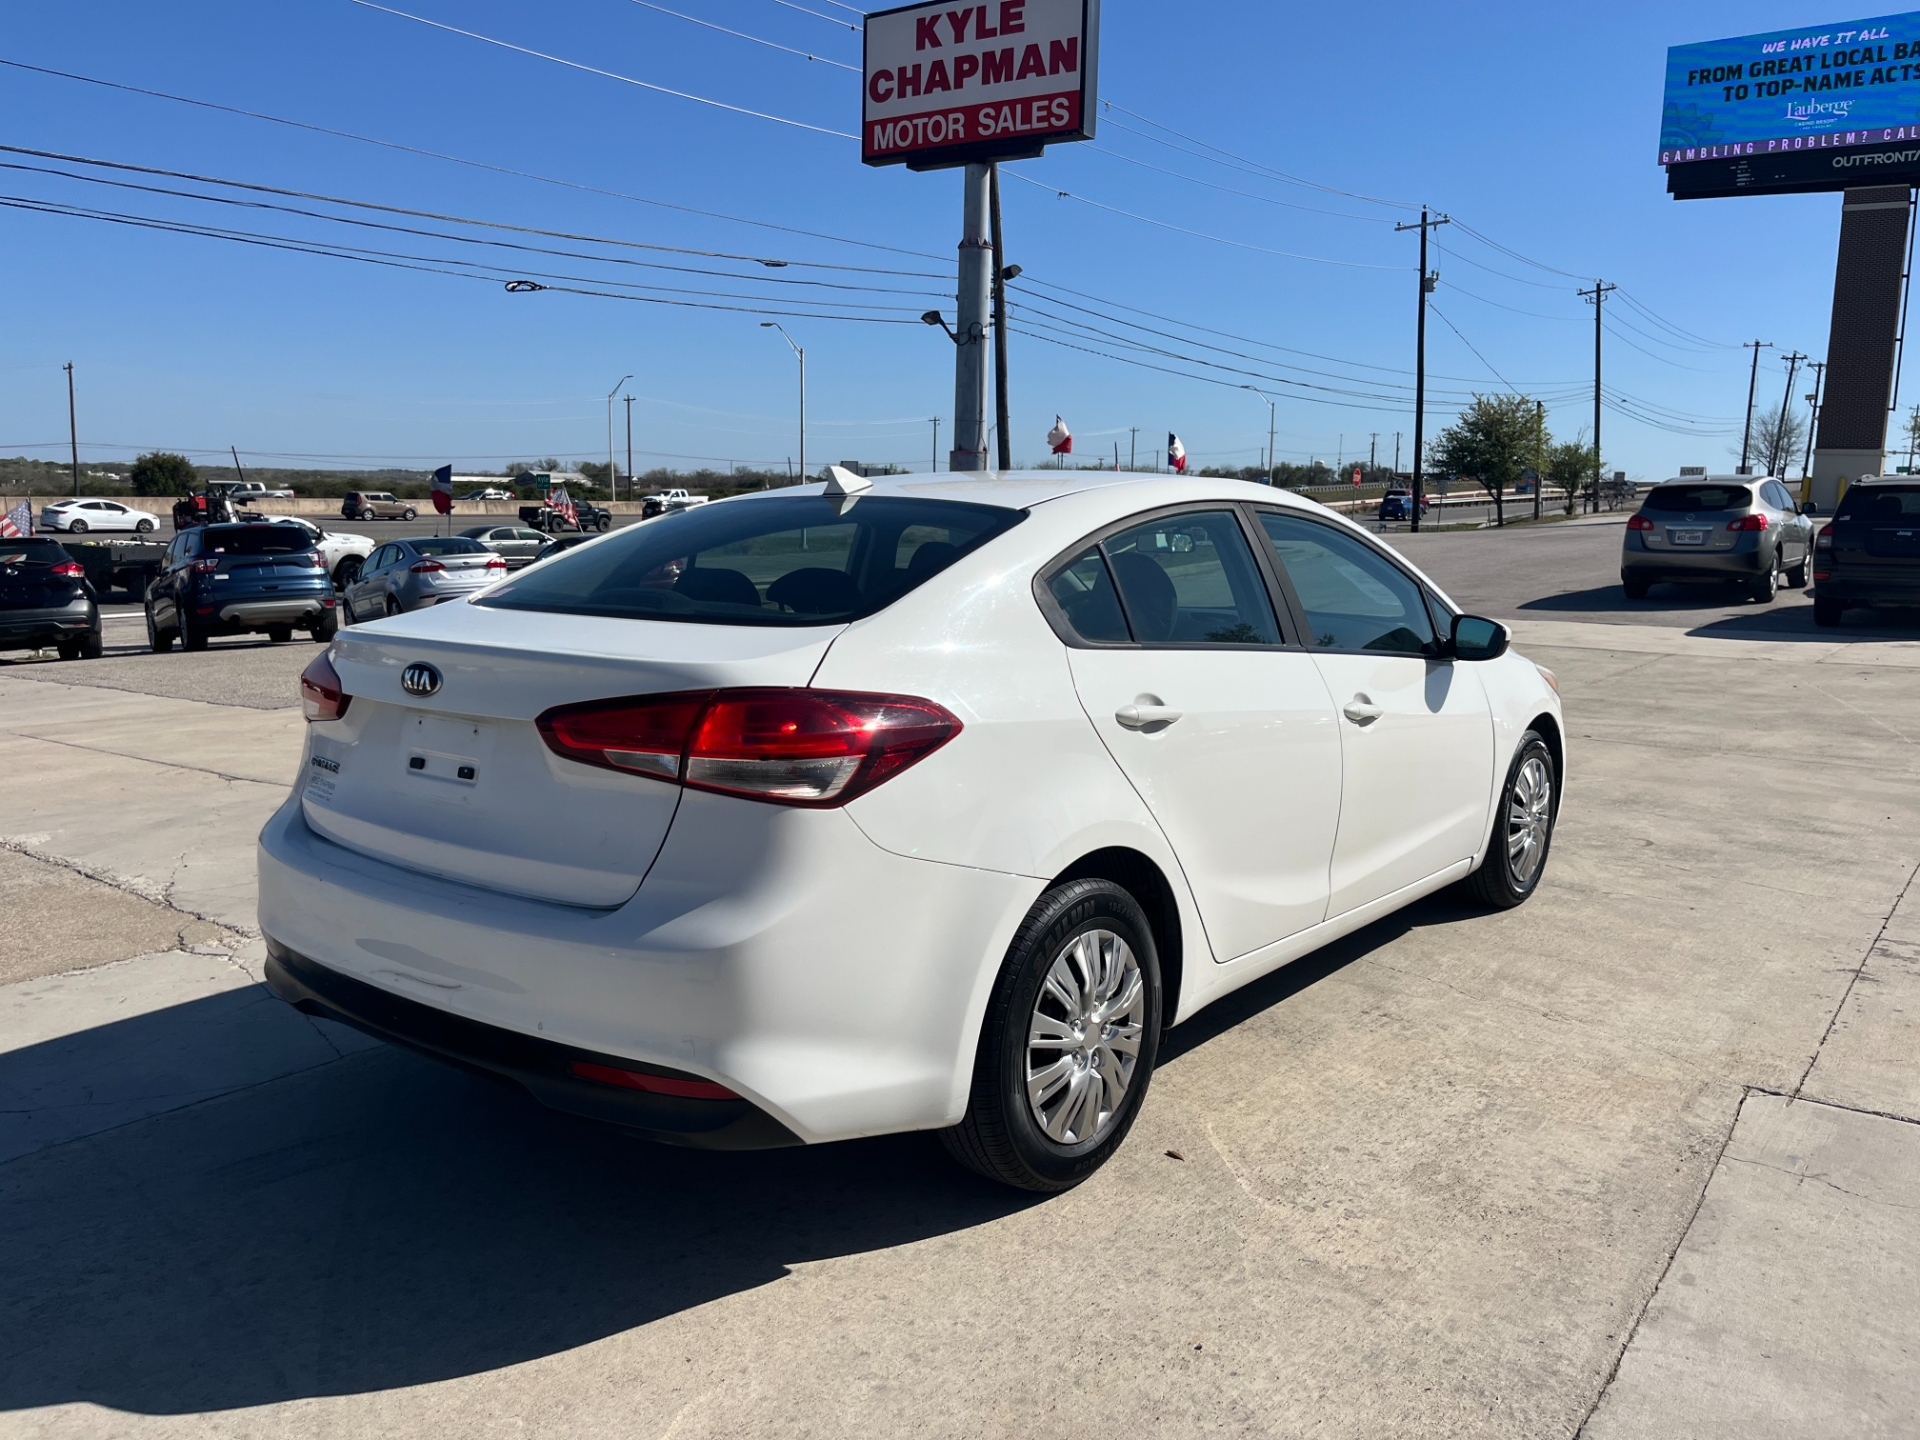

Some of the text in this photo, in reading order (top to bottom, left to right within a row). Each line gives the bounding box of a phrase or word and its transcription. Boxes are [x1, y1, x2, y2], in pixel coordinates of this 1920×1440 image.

[916, 0, 1026, 51] KYLE
[1762, 27, 1890, 54] WE HAVE IT ALL
[869, 36, 1078, 103] CHAPMAN
[1688, 64, 1743, 86] FROM
[1750, 54, 1816, 78] GREAT
[1820, 45, 1888, 69] LOCAL
[1723, 84, 1749, 102] TO
[1755, 69, 1866, 98] TOP-NAME
[874, 98, 1070, 150] MOTOR SALES
[1663, 126, 1917, 162] GAMBLING PROBLEM? CAL
[404, 669, 431, 691] KIA
[1033, 900, 1096, 976] SAILUN
